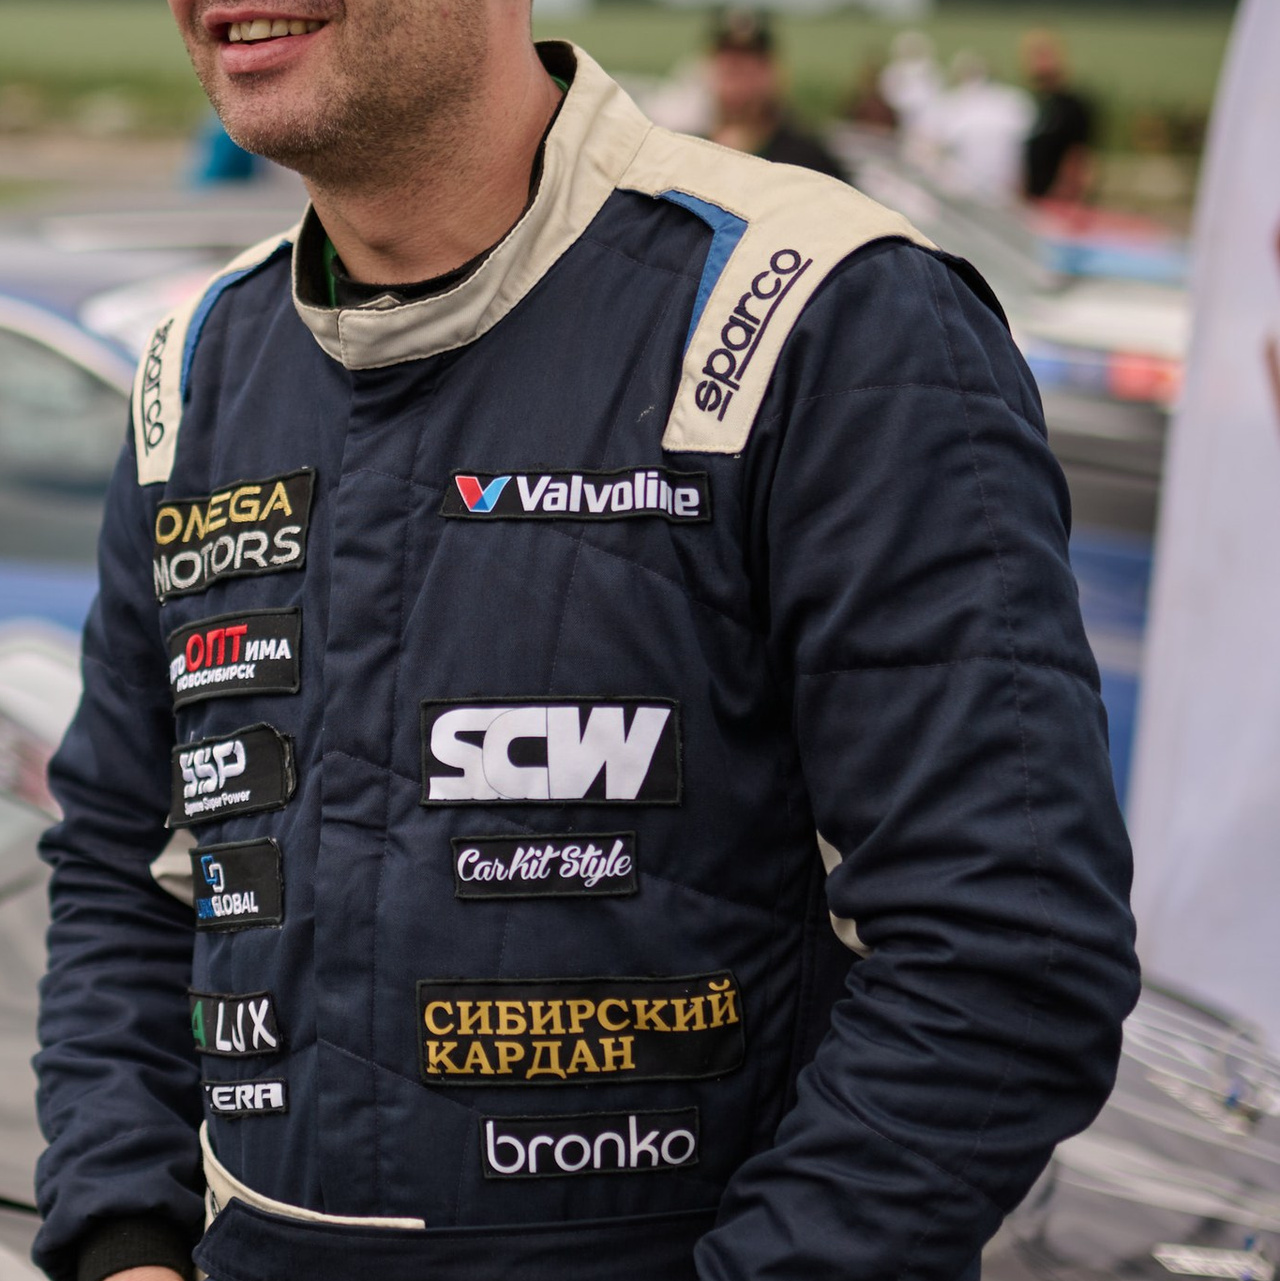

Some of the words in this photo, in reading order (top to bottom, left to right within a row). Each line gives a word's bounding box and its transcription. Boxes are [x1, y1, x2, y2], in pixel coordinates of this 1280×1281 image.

[696, 248, 812, 421] sparco
[516, 471, 700, 517] Valvoline
[153, 525, 302, 596] MOTORS
[180, 740, 246, 798] SSP
[429, 706, 671, 800] SCW
[560, 839, 632, 888] Style
[424, 979, 739, 1036] СИБИРСКИЙ
[426, 1035, 636, 1080] КАРДАН
[205, 1083, 284, 1111] ERA
[486, 1115, 696, 1174] bronko
